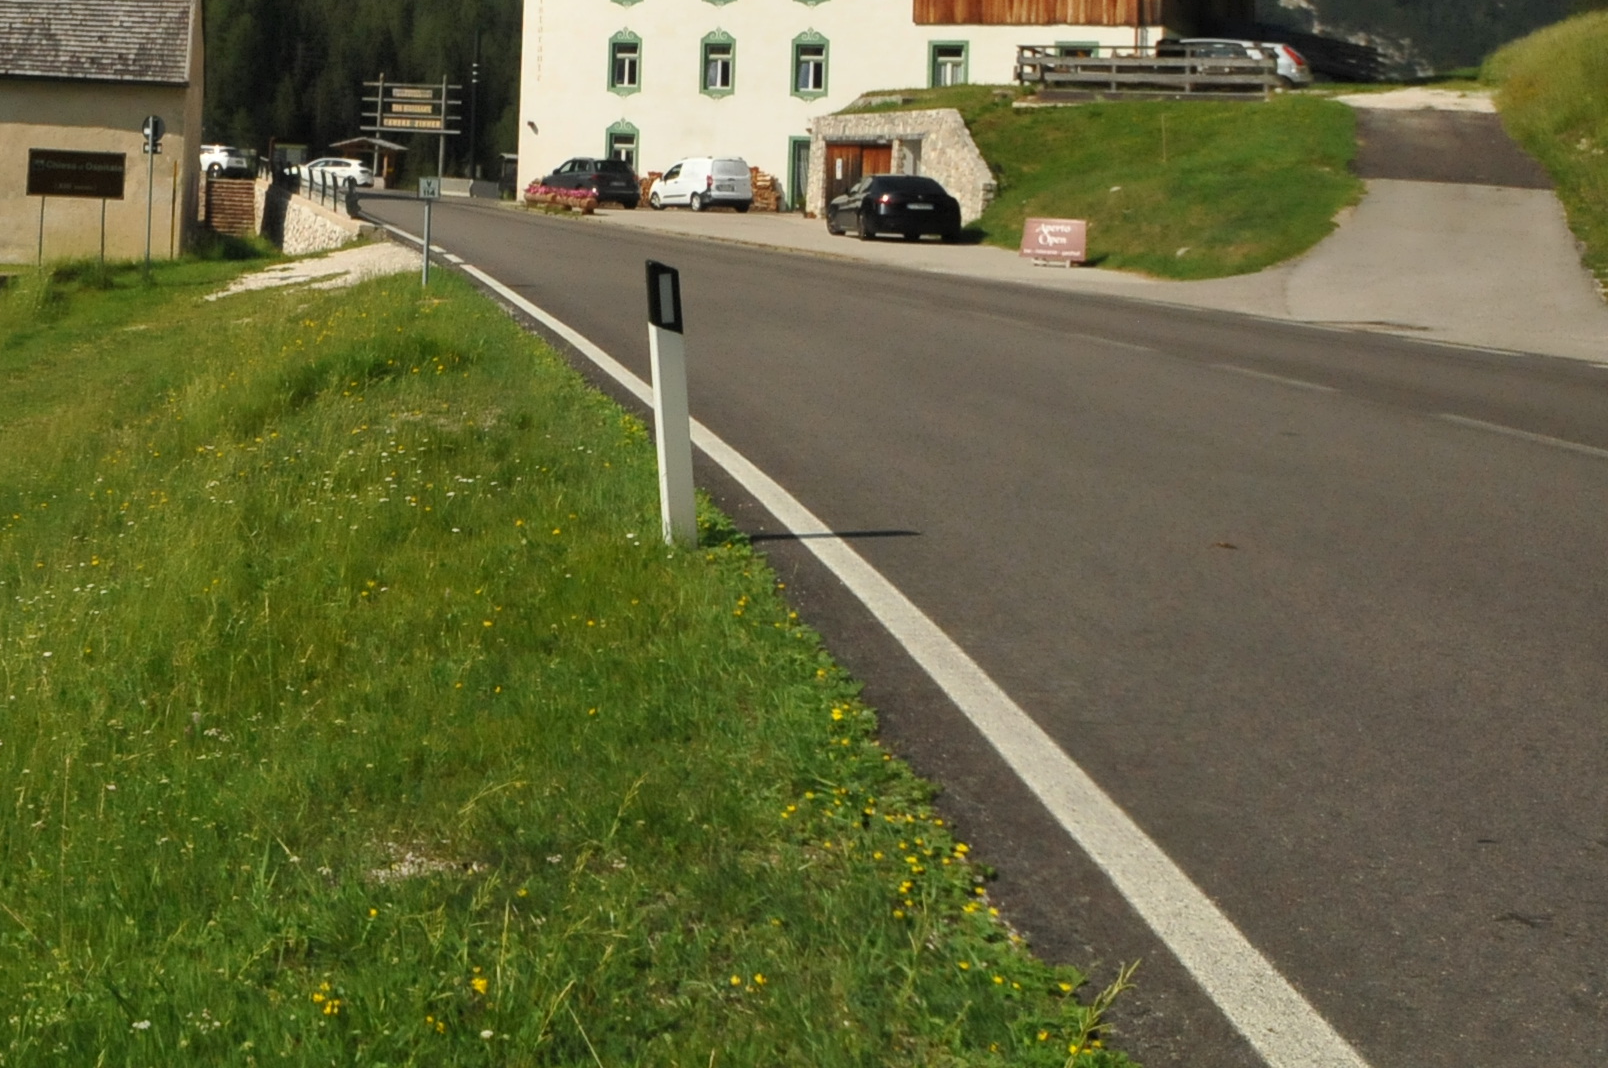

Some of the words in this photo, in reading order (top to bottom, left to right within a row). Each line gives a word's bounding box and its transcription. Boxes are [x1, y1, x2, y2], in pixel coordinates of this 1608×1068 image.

[85, 162, 123, 172] Ospitale
[1035, 223, 1071, 234] Aperto
[1038, 234, 1067, 247] Open
